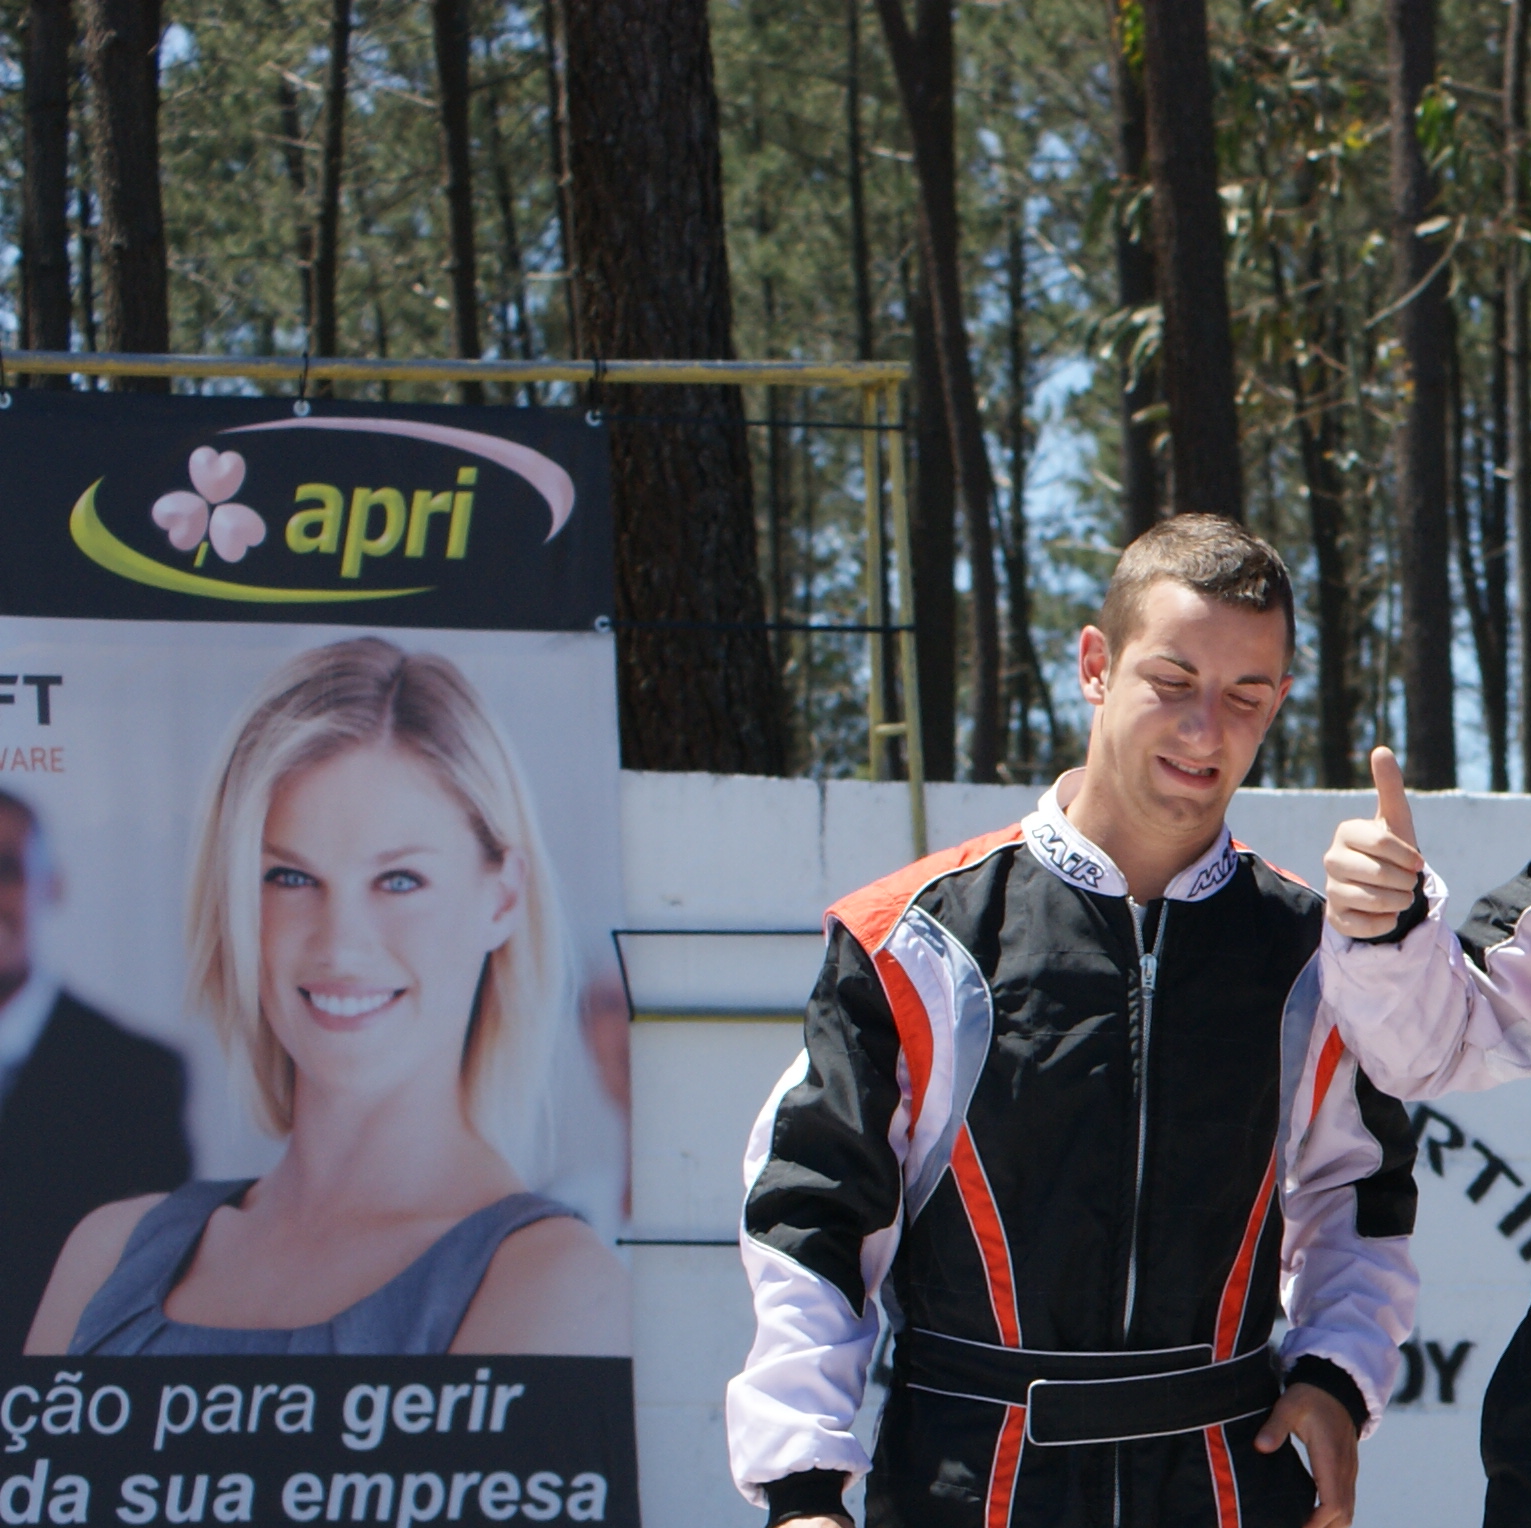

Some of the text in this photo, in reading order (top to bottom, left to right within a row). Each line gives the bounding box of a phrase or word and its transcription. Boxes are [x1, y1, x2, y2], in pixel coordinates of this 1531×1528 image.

[285, 466, 478, 579] apri
[153, 1384, 316, 1451] para
[341, 1367, 526, 1451] gerir
[0, 1458, 90, 1526] da
[115, 1473, 256, 1525] sua
